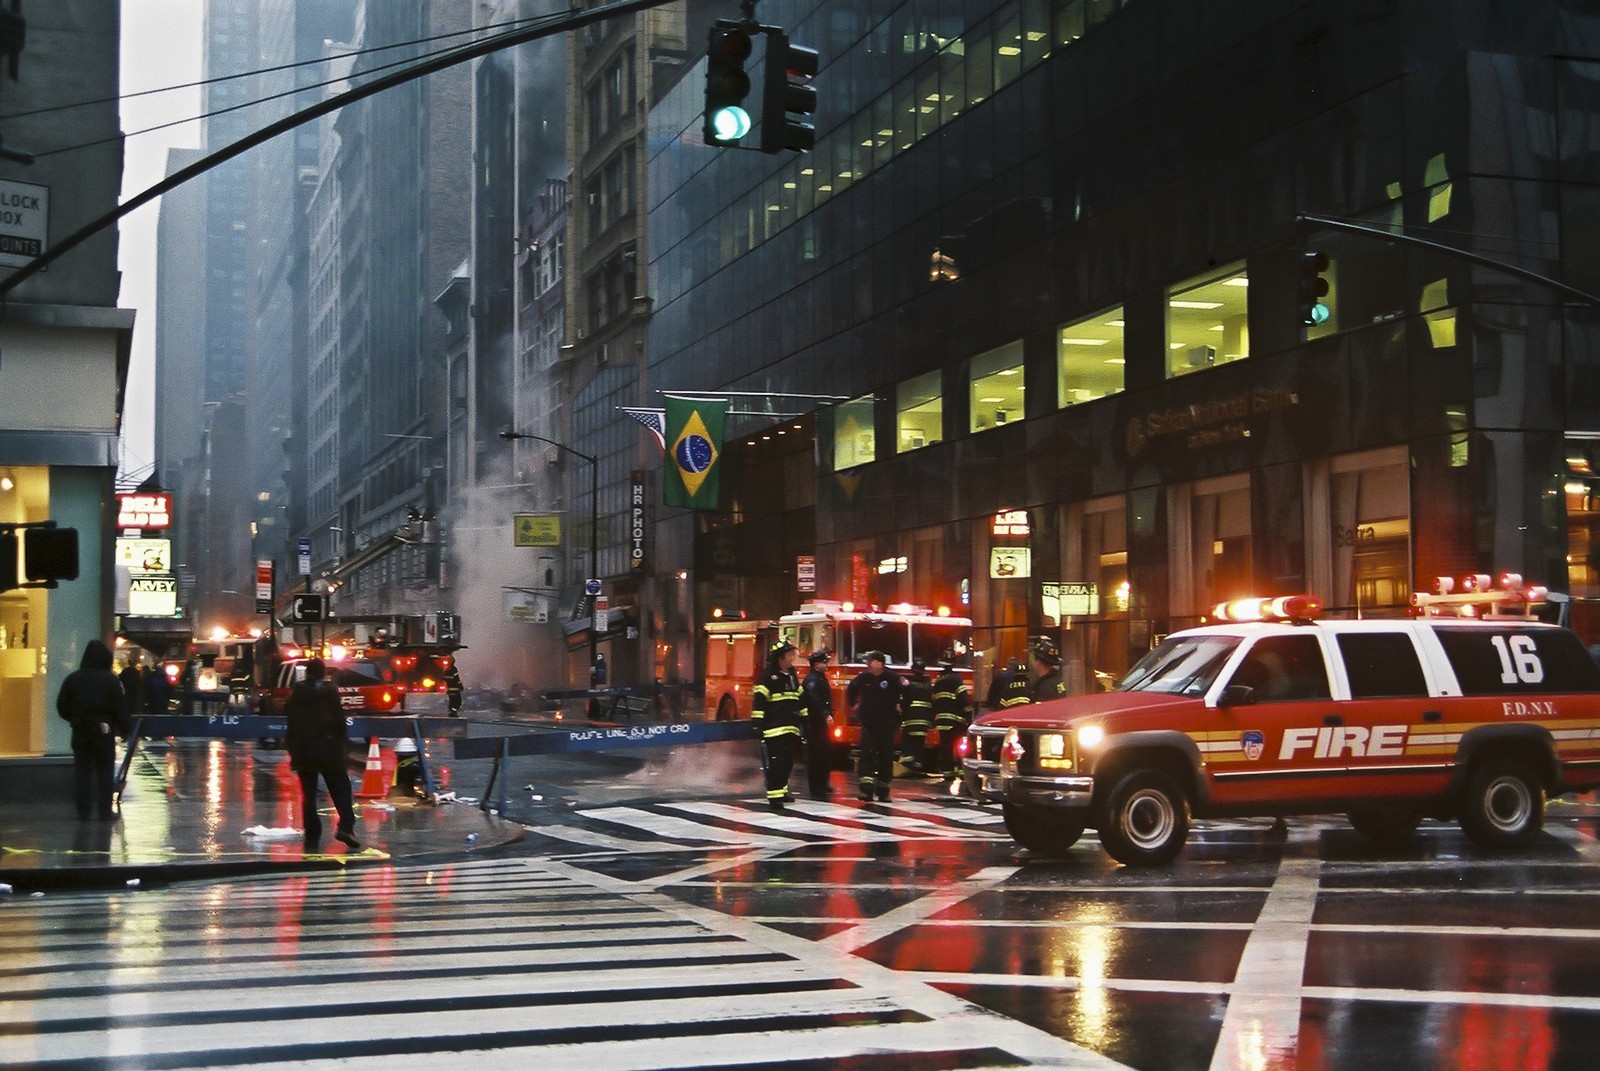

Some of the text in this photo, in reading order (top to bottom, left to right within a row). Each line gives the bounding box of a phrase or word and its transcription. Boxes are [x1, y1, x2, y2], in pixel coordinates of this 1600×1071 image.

[0, 210, 23, 227] OX
[633, 508, 643, 558] PHOTO
[1491, 635, 1544, 684] 16
[648, 725, 667, 735] NOT
[1278, 725, 1408, 760] FIRE
